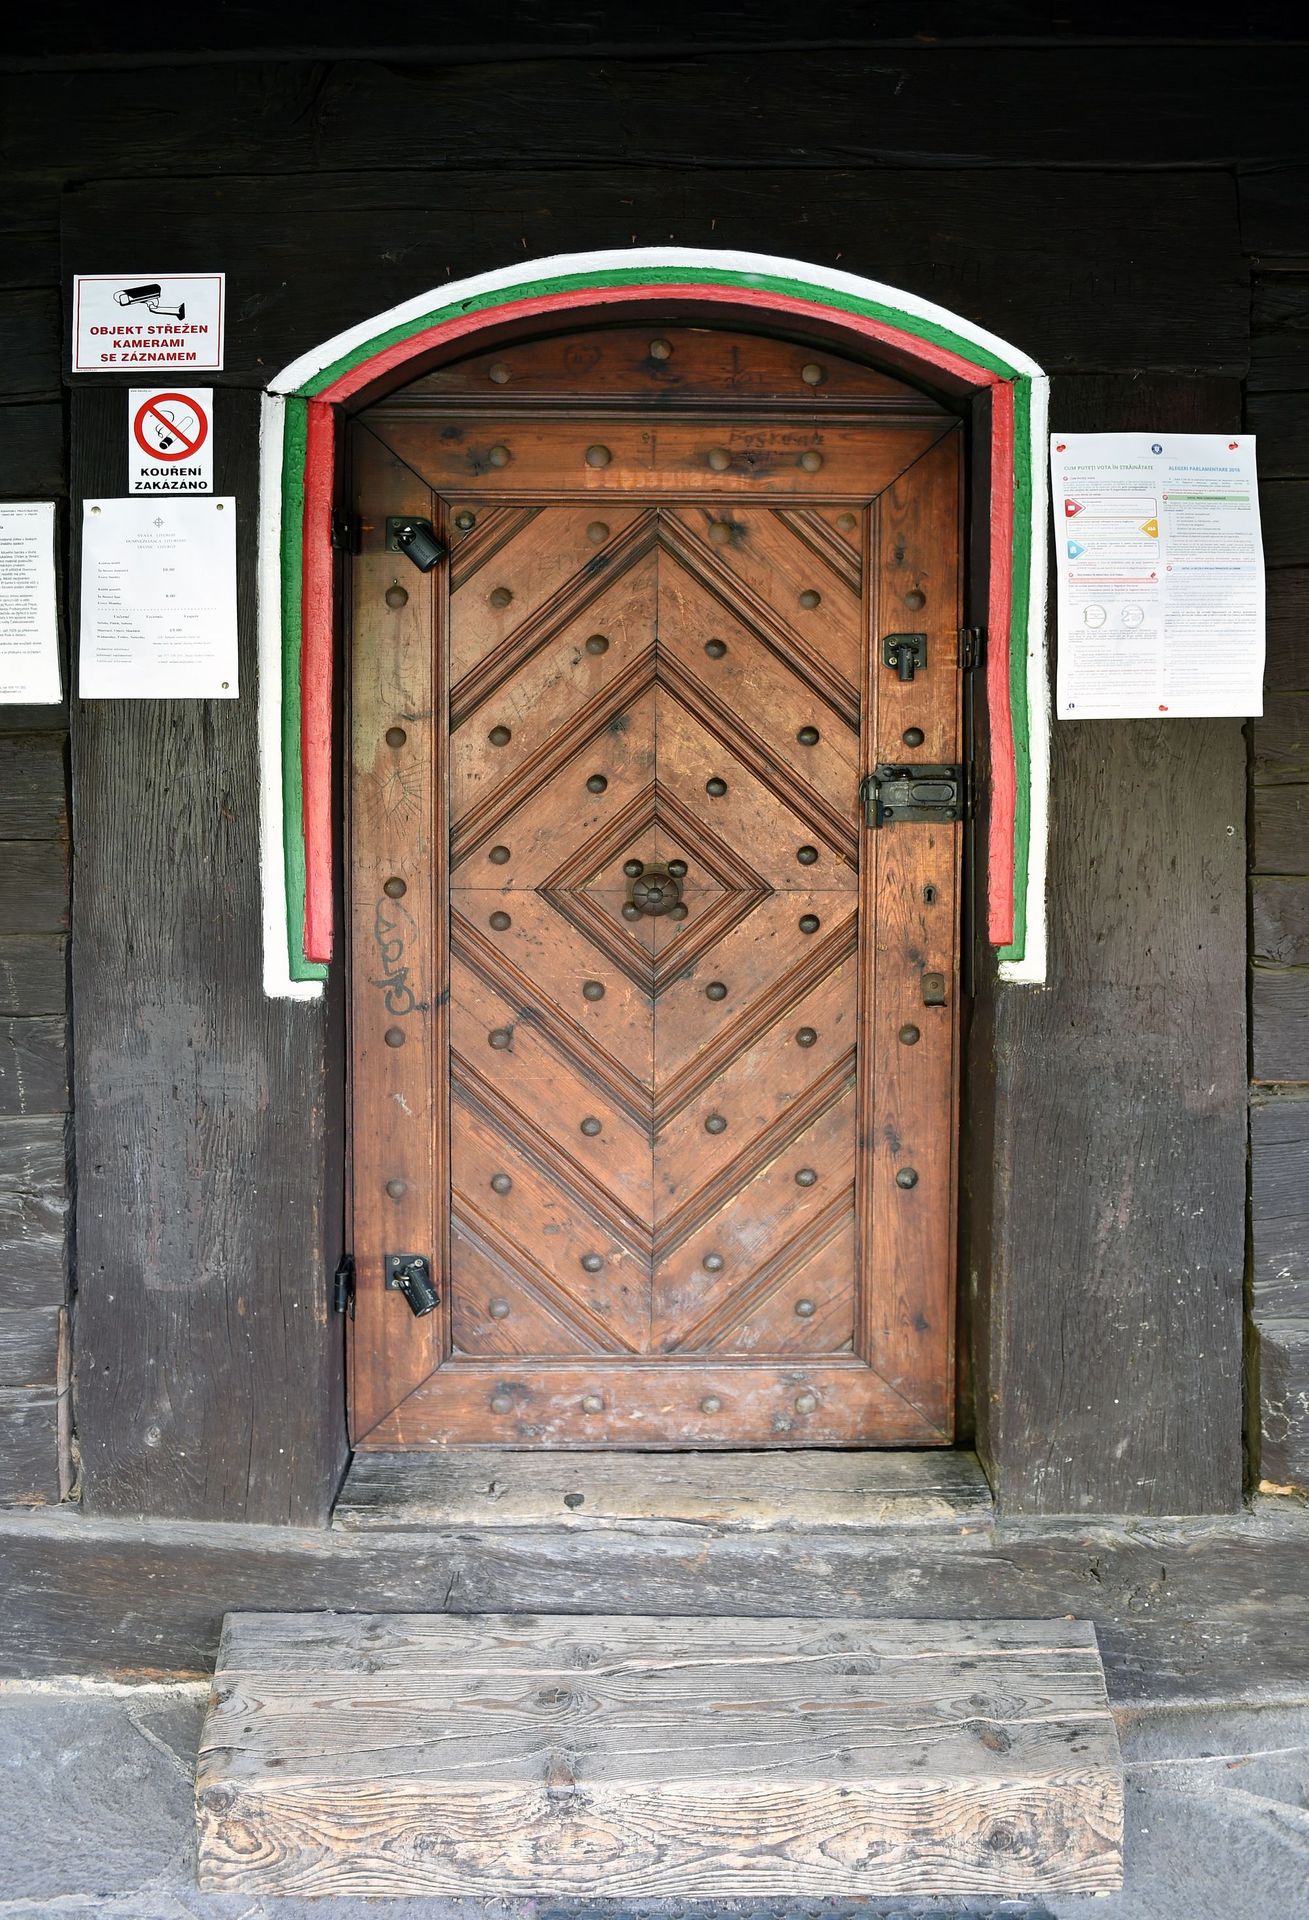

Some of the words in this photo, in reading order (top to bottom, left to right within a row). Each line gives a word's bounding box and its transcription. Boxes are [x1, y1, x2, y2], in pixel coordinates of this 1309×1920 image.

[90, 326, 143, 335] OBJEKT
[147, 323, 208, 334] STŘEŽEN
[113, 338, 185, 348] KAMERAMI
[100, 353, 117, 362] SE
[121, 350, 197, 362] ZÁZNAMEM
[140, 465, 202, 477] KOUŘENÍ
[134, 479, 208, 490] ZAKÁZÁNO
